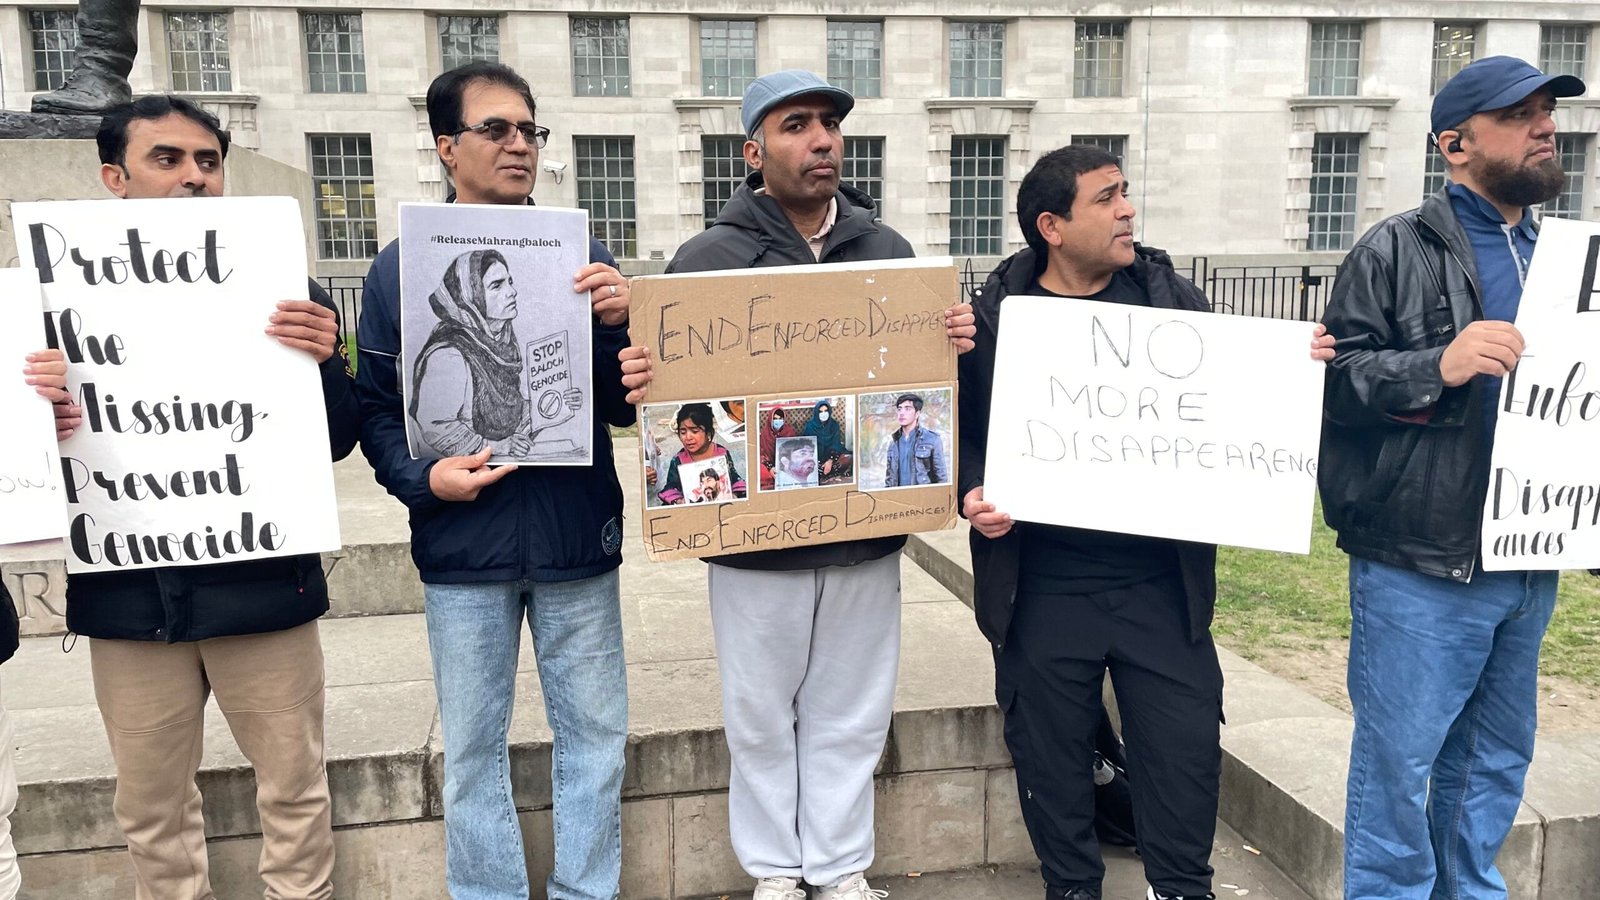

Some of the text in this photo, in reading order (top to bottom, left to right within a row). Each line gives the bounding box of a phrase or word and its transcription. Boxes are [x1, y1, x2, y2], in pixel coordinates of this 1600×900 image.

[29, 222, 233, 285] Protect
[430, 234, 562, 248] #ReleaseMahrangbaloch
[43, 307, 127, 365] The
[533, 340, 563, 362] STOP
[657, 301, 743, 364] END
[747, 294, 867, 357] ENFORCED
[1092, 312, 1204, 379] NO
[530, 356, 564, 377] BALOCH
[530, 370, 568, 391] GENOCIDE
[1050, 375, 1208, 421] MORE
[60, 453, 250, 503] Prevent
[70, 511, 287, 567] Genocide
[649, 515, 711, 553] END
[717, 502, 838, 551] ENFORCED
[1493, 530, 1567, 558] ances
